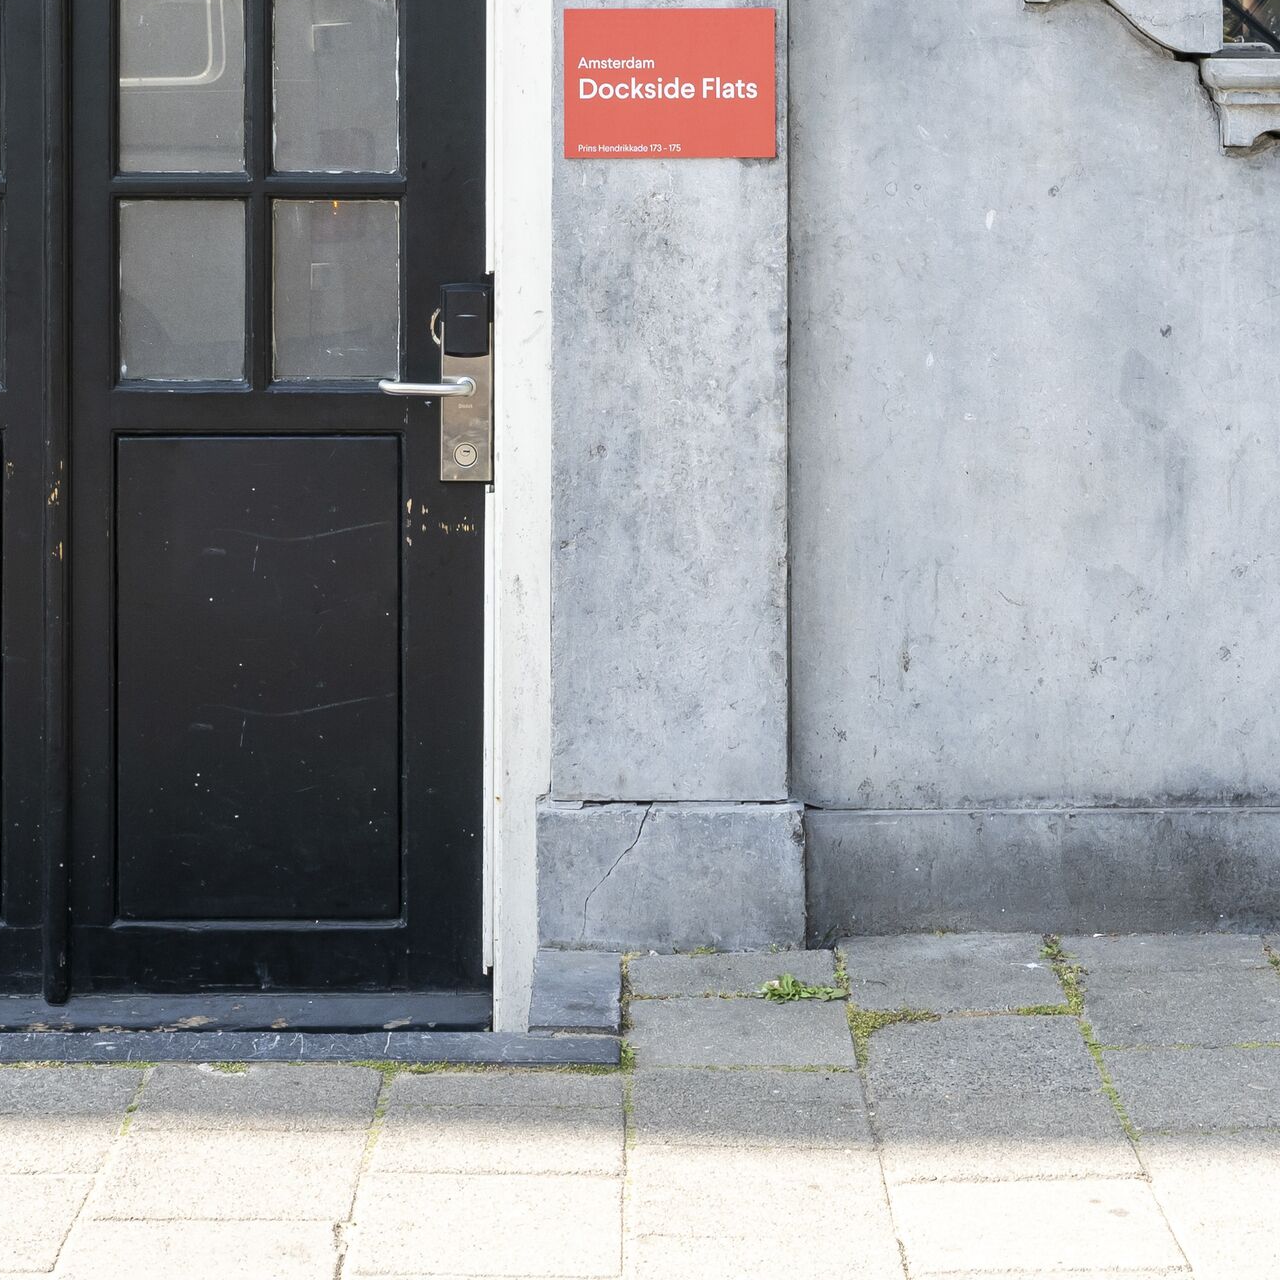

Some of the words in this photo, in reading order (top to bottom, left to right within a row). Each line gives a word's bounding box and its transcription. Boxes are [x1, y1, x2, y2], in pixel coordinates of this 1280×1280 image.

[578, 57, 655, 69] Amsterdam
[579, 77, 696, 100] Dockside
[702, 77, 758, 99] Flats
[578, 144, 597, 153] Prins
[598, 144, 649, 153] Hendrikkade
[650, 144, 662, 152] 173
[669, 144, 682, 152] 175
